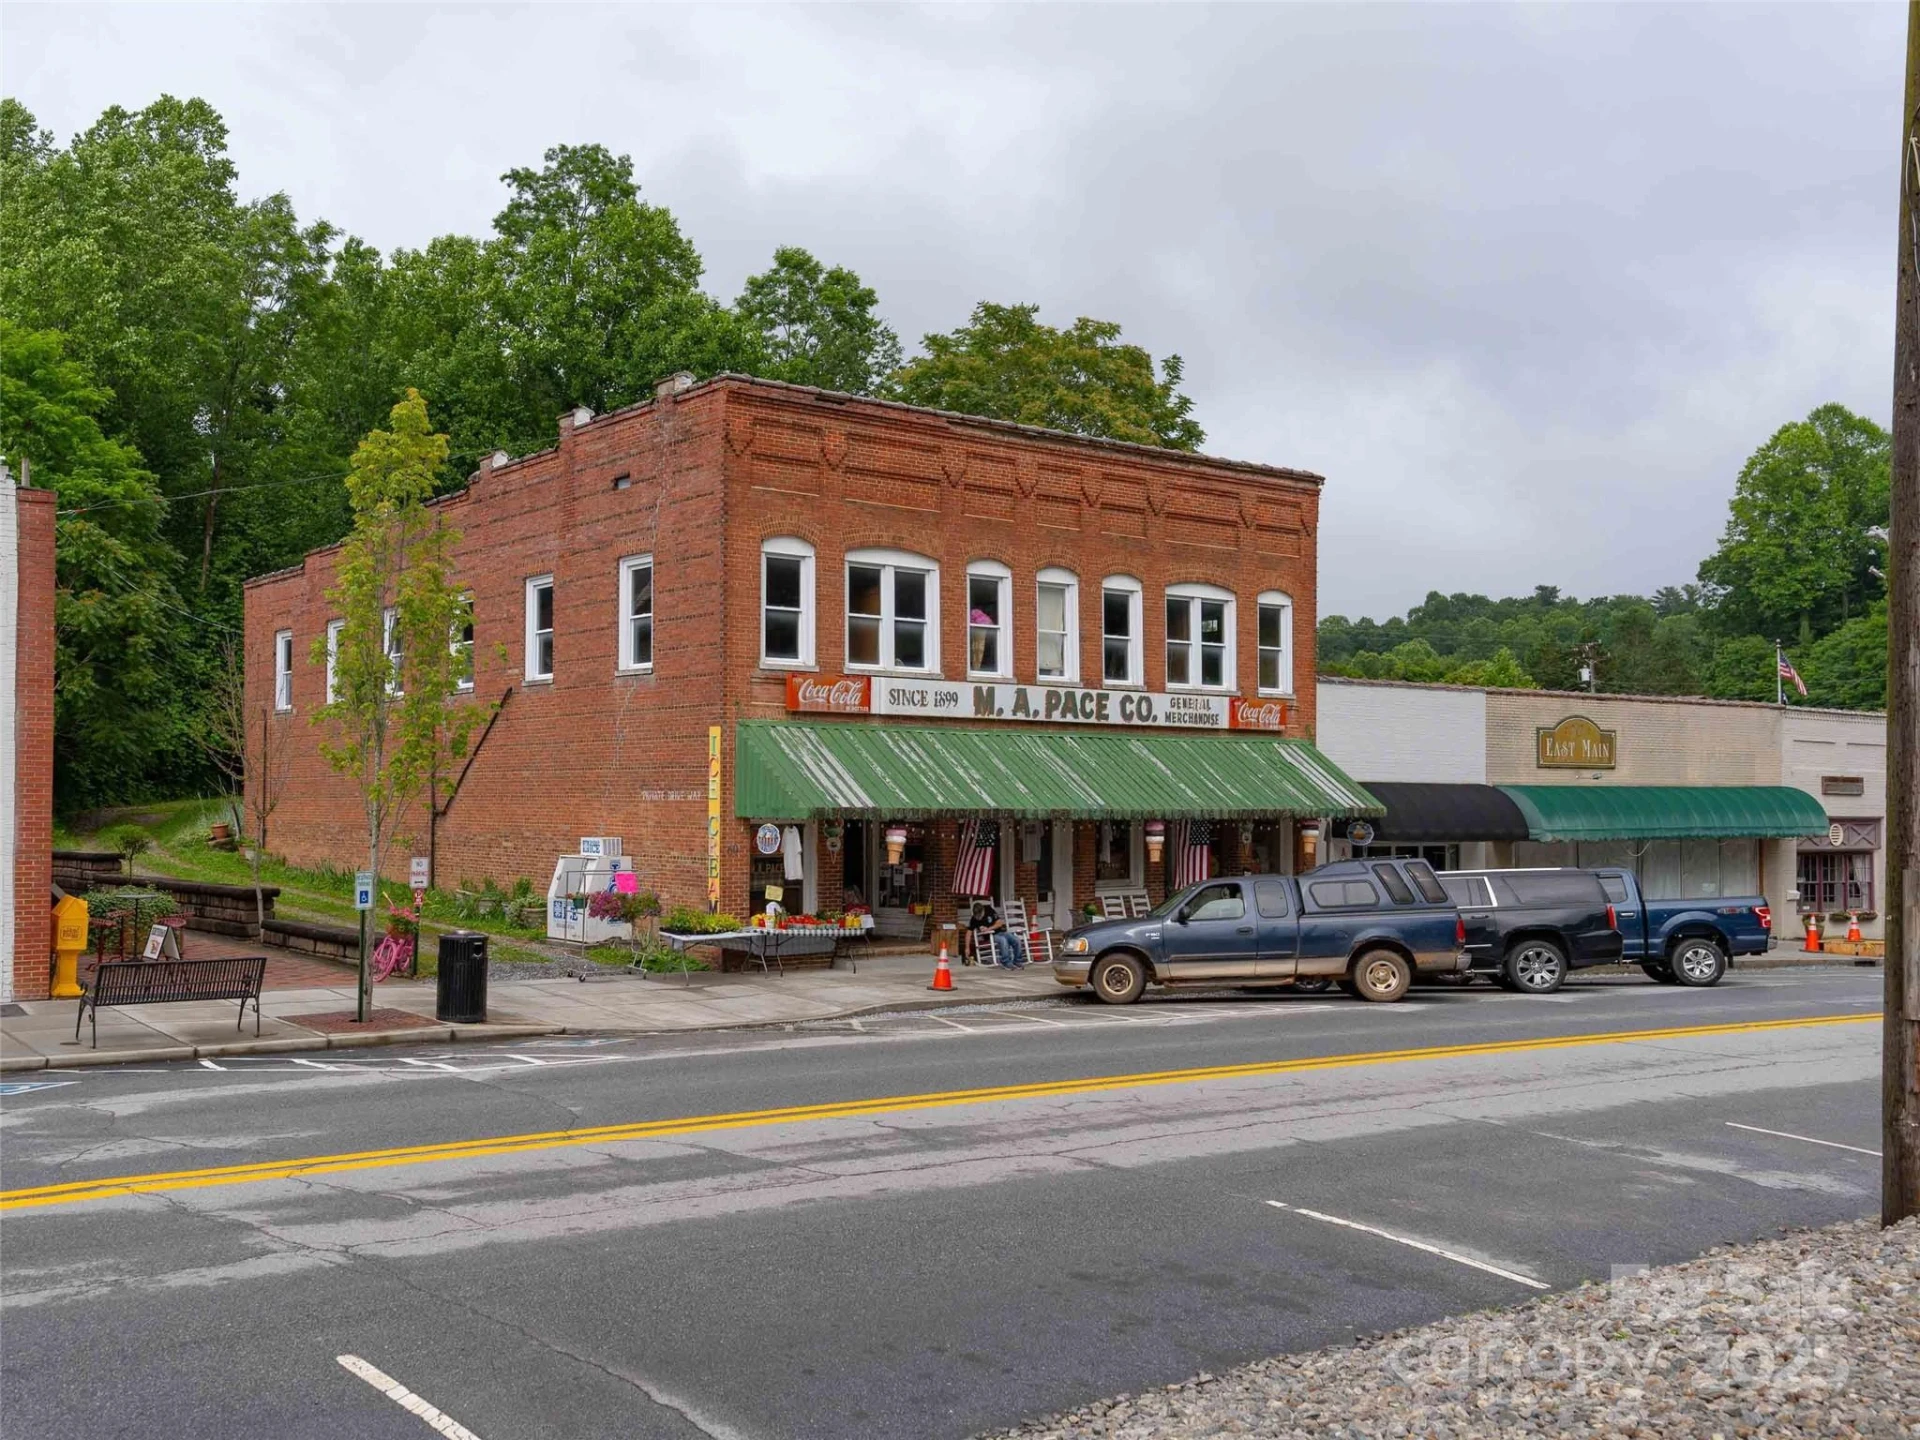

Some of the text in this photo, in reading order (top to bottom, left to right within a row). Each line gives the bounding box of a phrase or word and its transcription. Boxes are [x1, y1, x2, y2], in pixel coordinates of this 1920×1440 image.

[889, 688, 958, 708] SINCE 1899
[973, 685, 1158, 723] M. A. PACE CO.
[1165, 711, 1220, 726] MERCHANDISE
[708, 735, 719, 800] ICE
